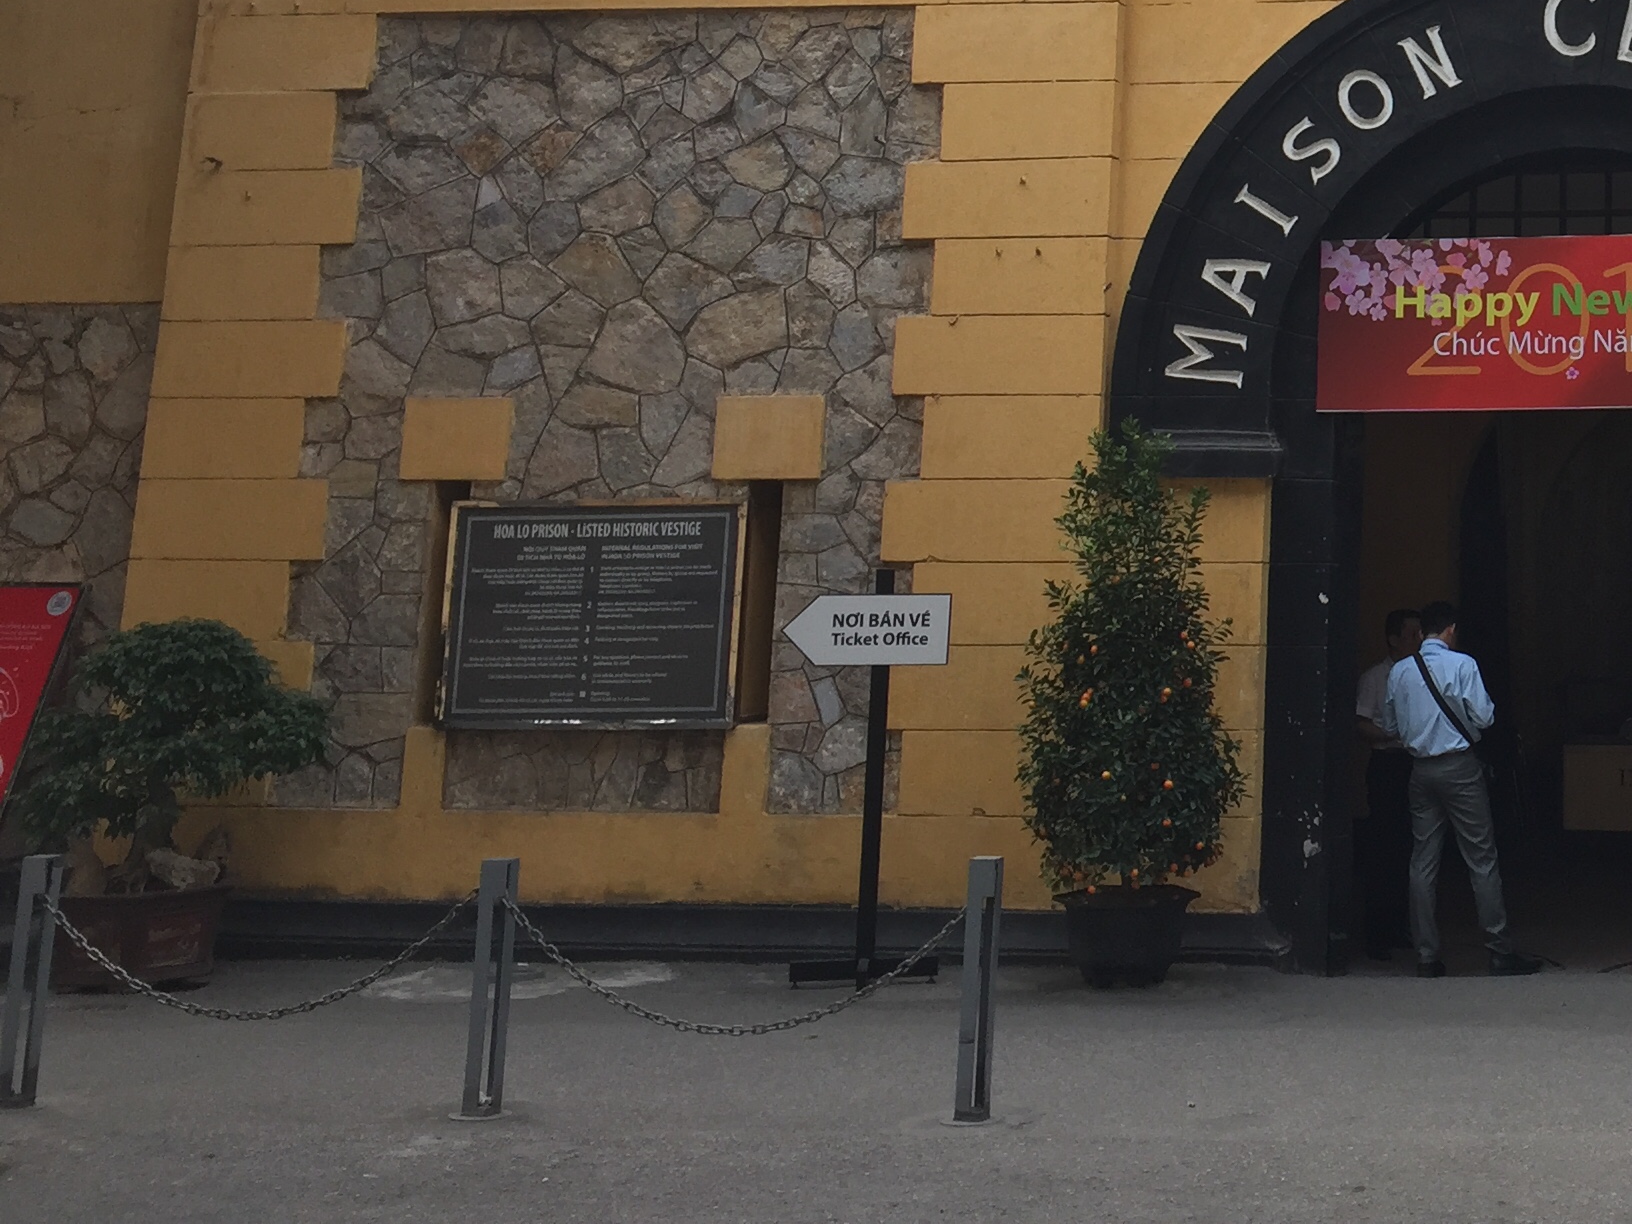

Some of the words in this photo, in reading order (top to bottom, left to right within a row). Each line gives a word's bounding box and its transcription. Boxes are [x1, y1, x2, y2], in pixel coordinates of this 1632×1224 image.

[1164, 24, 1463, 389] MAISON
[1395, 285, 1541, 327] Happy
[1433, 330, 1500, 357] Chúc
[1508, 329, 1585, 360] Mừng
[531, 523, 569, 538] PRISON
[612, 521, 659, 537] HISTORIC
[660, 520, 702, 536] VESTIGE
[832, 612, 864, 628] NƠI
[868, 610, 905, 627] BÁN
[909, 610, 931, 627] VÉ
[831, 633, 879, 646] Ticket
[882, 631, 929, 646] Office
